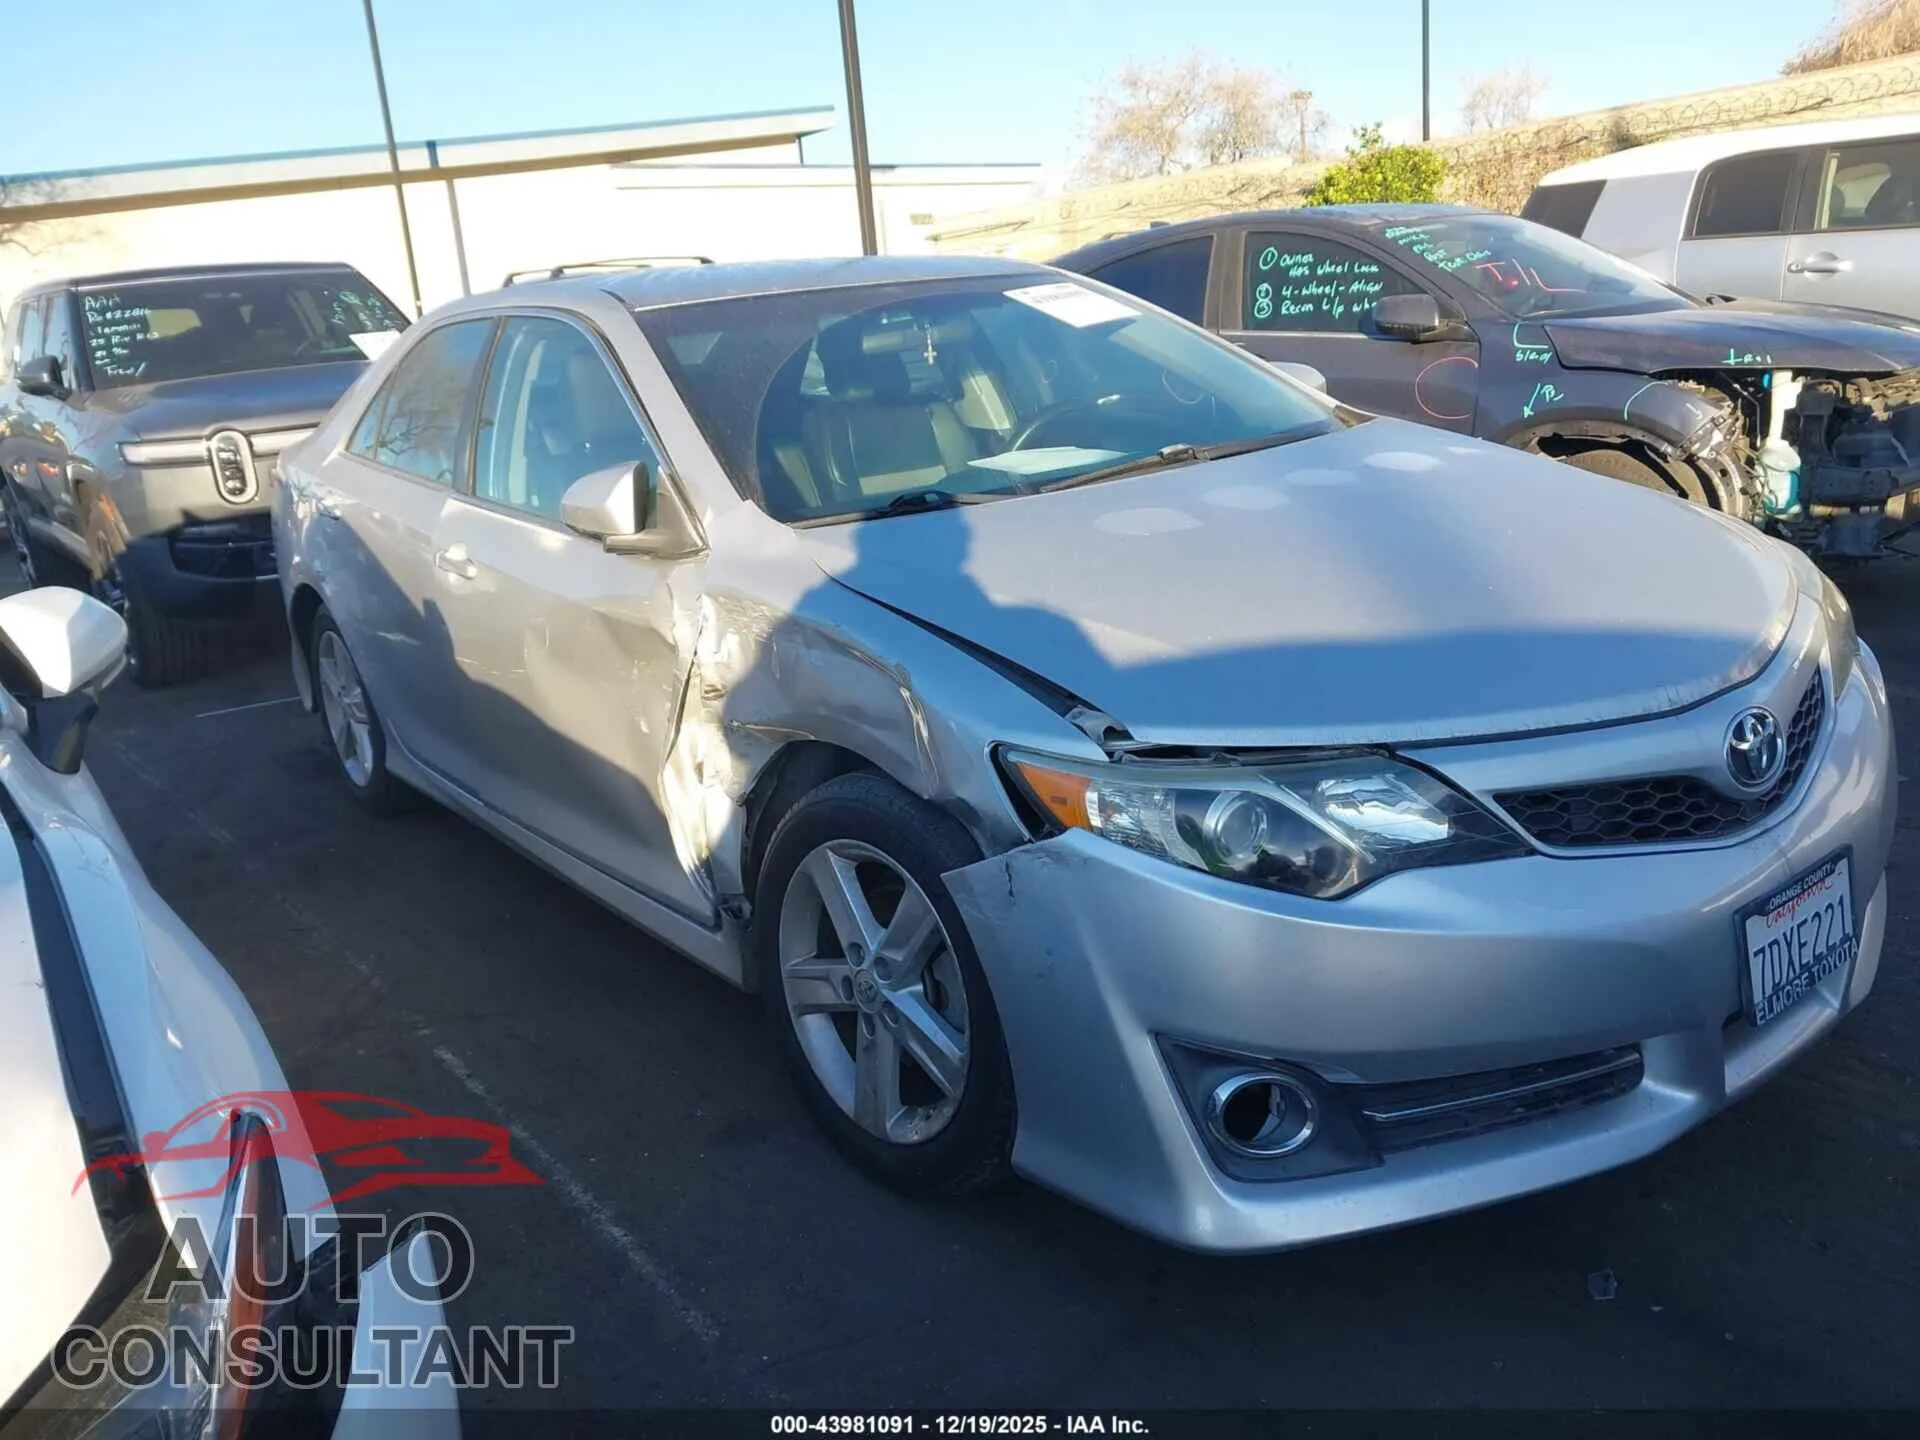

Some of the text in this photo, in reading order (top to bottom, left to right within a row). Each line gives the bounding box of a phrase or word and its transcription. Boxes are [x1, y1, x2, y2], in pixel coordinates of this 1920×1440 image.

[1769, 882, 1803, 911] ORANGE
[1753, 894, 1850, 998] 7DXE221
[1756, 938, 1859, 1026] ELMORE TOYOTA
